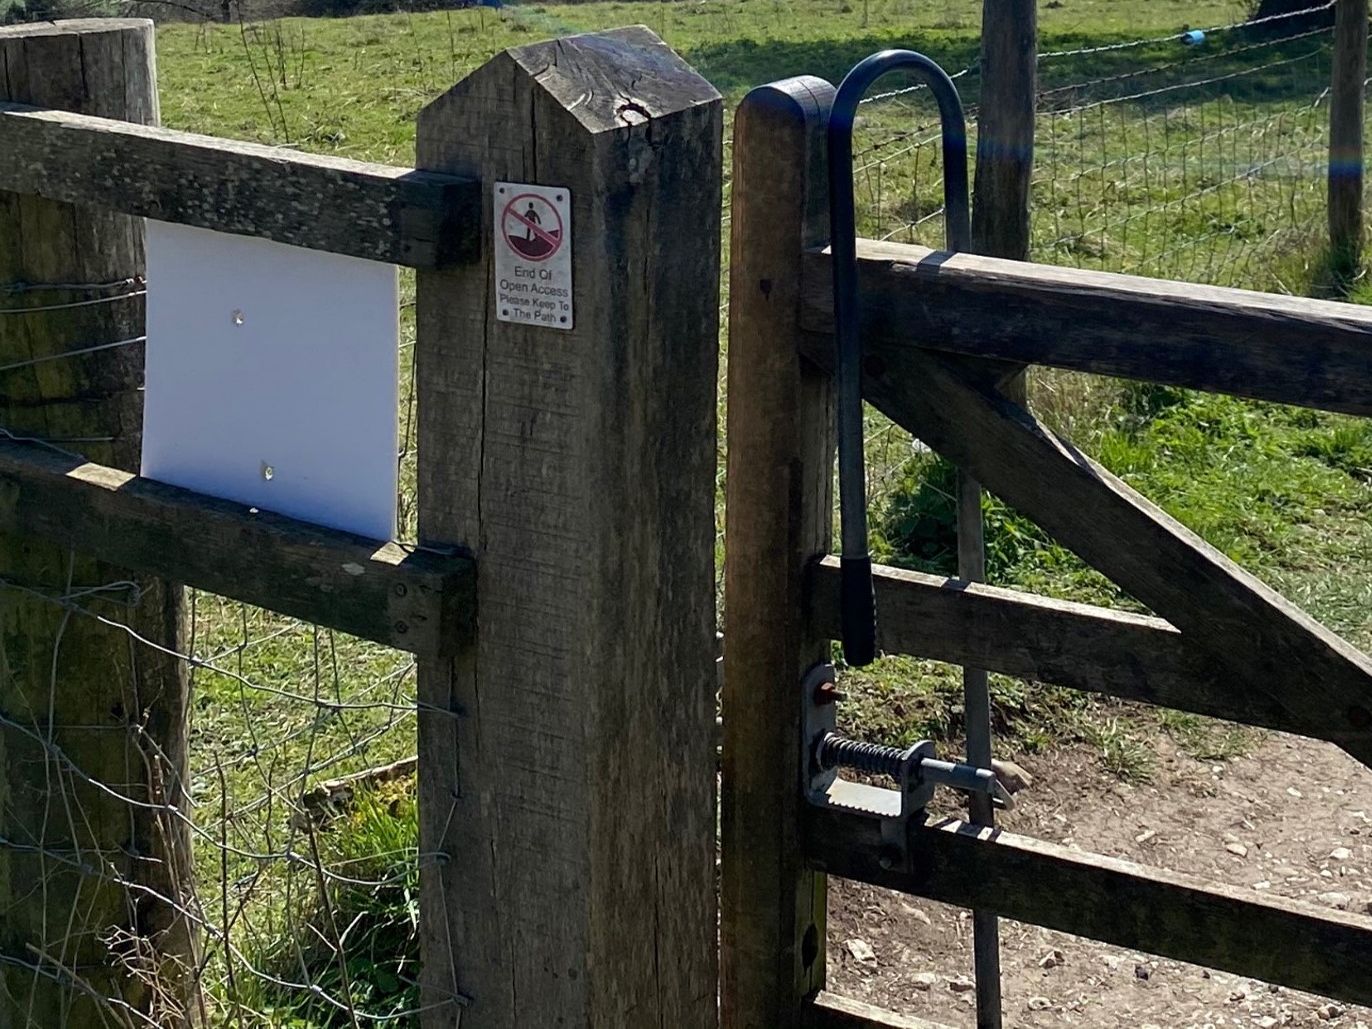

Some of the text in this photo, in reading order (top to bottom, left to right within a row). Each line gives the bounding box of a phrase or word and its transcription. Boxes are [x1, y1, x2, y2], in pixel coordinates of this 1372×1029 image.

[514, 266, 552, 281] End Of
[500, 278, 569, 298] Open Access
[500, 293, 569, 311] Please Keep To
[513, 307, 556, 323] The Path
